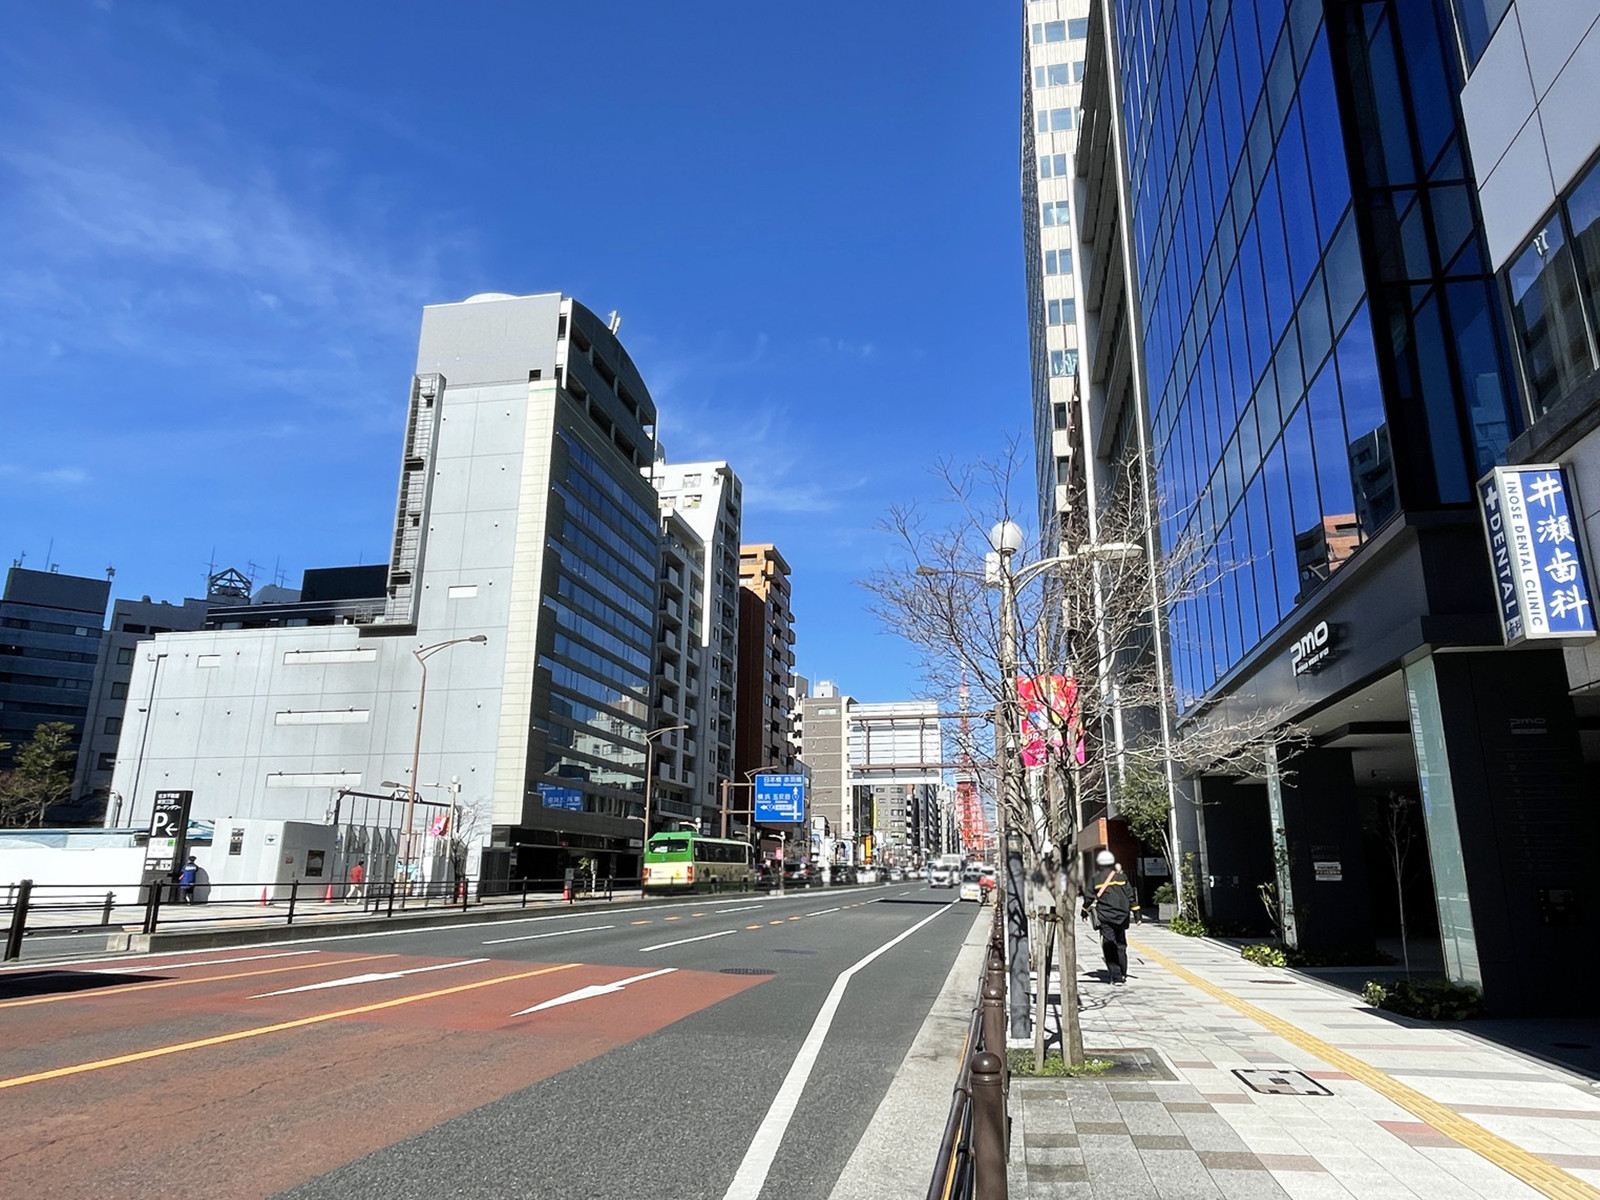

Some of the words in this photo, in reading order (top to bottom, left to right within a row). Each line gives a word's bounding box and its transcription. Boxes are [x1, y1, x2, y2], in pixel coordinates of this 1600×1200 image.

[1506, 481, 1523, 519] INOSE
[1490, 514, 1515, 614] DENTAL
[1514, 526, 1532, 574] DENTAL
[1526, 472, 1590, 629] 井瀬歯科
[1524, 581, 1543, 626] CLINIC
[151, 812, 168, 836] P
